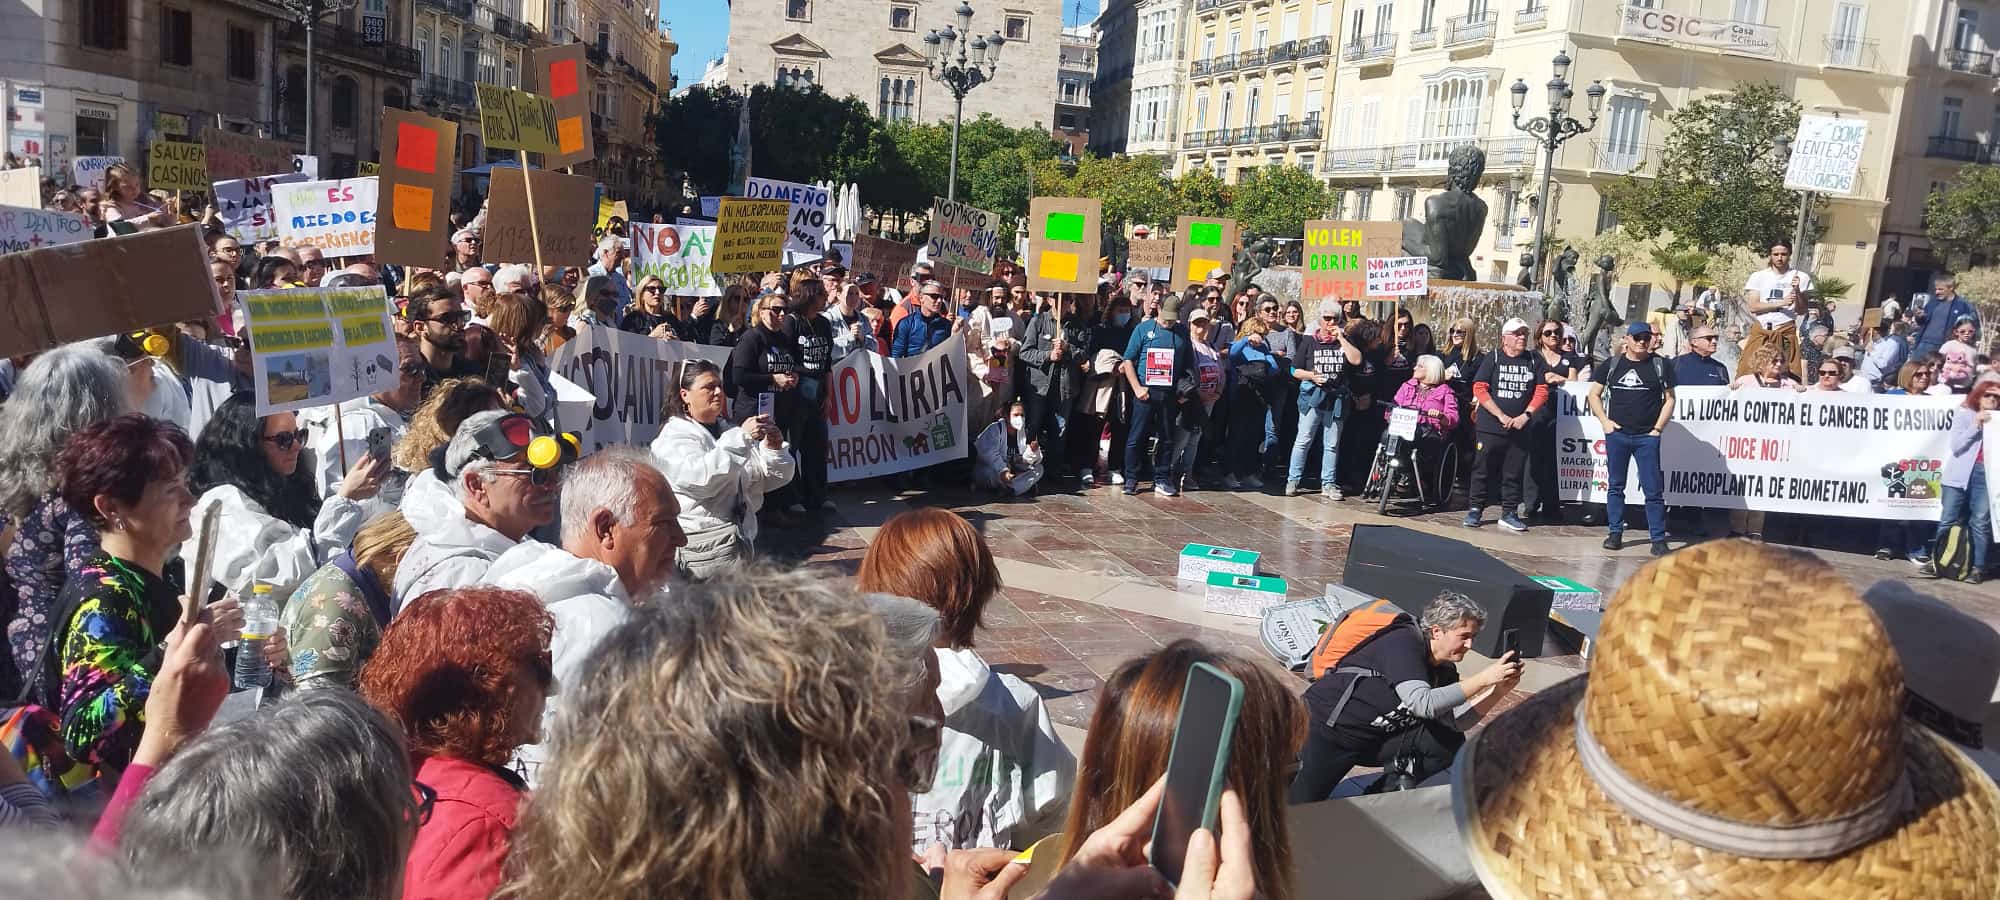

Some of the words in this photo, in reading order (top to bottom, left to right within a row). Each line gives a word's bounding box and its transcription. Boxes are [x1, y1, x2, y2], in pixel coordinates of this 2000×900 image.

[1643, 12, 1700, 36] CSIC
[1732, 25, 1753, 35] Casa
[540, 98, 559, 147] NO
[1832, 126, 1865, 144] COME
[1796, 140, 1860, 160] LENTEJAS
[328, 186, 354, 203] ES
[747, 180, 828, 207] DOMEÑO
[793, 208, 825, 228] NO
[934, 198, 952, 218] NO
[24, 211, 82, 233] DENTRO
[292, 211, 356, 229] MIEDO
[633, 224, 682, 258] NO
[682, 227, 714, 258] AL
[1307, 227, 1363, 248] VOLEM
[1310, 252, 1359, 273] OBRIR
[1367, 257, 1384, 270] NO
[1369, 272, 1379, 280] DE
[1380, 271, 1390, 279] LA
[1394, 267, 1425, 279] PLANTA
[1313, 356, 1344, 364] PUEBLO
[1499, 364, 1507, 373] NI
[1508, 365, 1519, 374] EN
[1498, 372, 1529, 382] PUEBLO
[1498, 381, 1507, 390] NI
[869, 353, 965, 424] LLIRIA
[1498, 390, 1514, 399] MIO
[1563, 393, 1578, 417] LA
[1680, 399, 1695, 420] LA
[1699, 399, 1739, 422] LUCHA
[1744, 400, 1796, 425] CONTRA
[1800, 403, 1813, 426] EL
[1819, 405, 1869, 430] CANCER
[1874, 407, 1889, 430] DE
[1894, 408, 1955, 431] CASINOS
[1899, 458, 1943, 473] STOP
[1560, 480, 1589, 490] LLIRIA
[1670, 470, 1763, 498] MACROPLANTA
[1769, 476, 1785, 499] DE
[1789, 477, 1869, 504] BIOMETANO.
